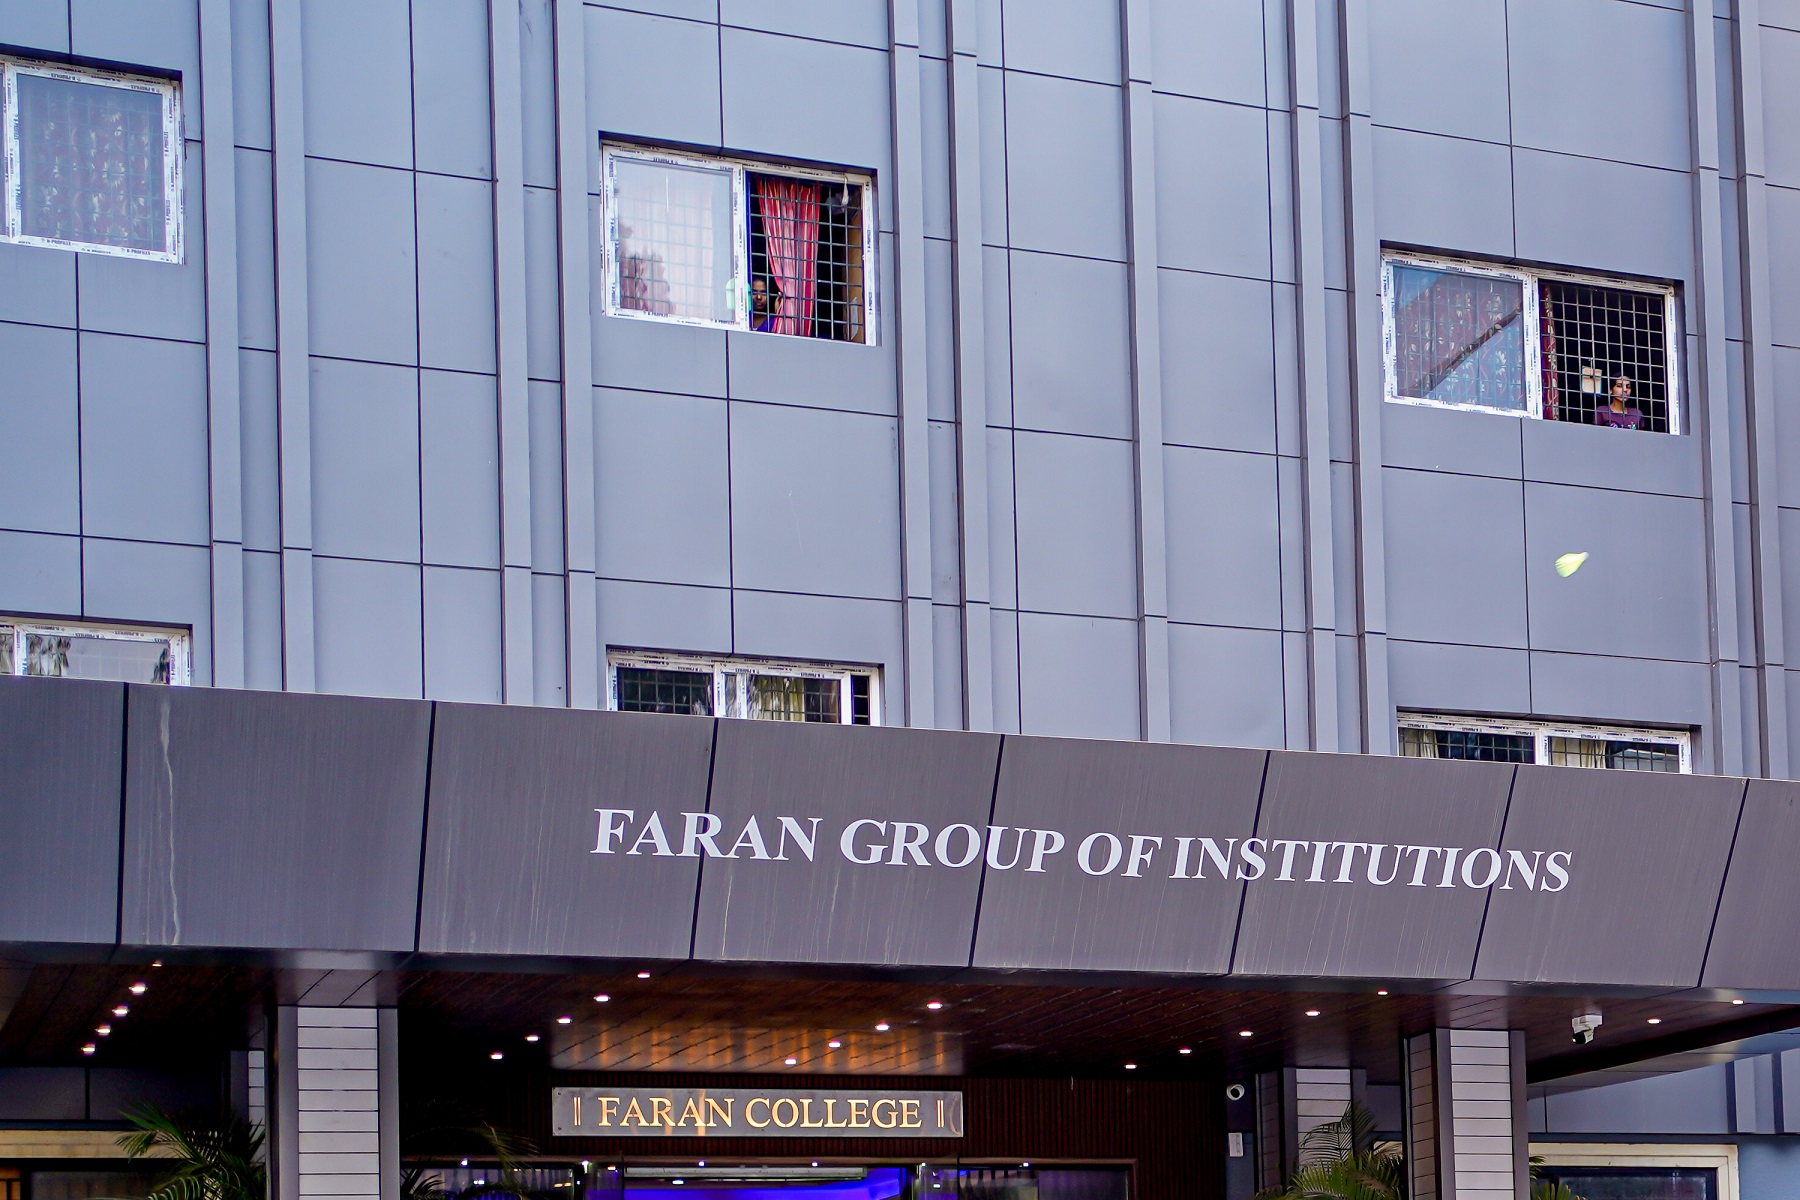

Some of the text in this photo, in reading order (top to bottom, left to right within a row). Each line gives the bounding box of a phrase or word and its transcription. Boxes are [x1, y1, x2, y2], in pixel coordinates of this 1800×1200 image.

[590, 808, 1574, 893] FARAN GROUP OF INSTITUTIONS
[598, 1096, 923, 1129] FARAN COLLEGE
